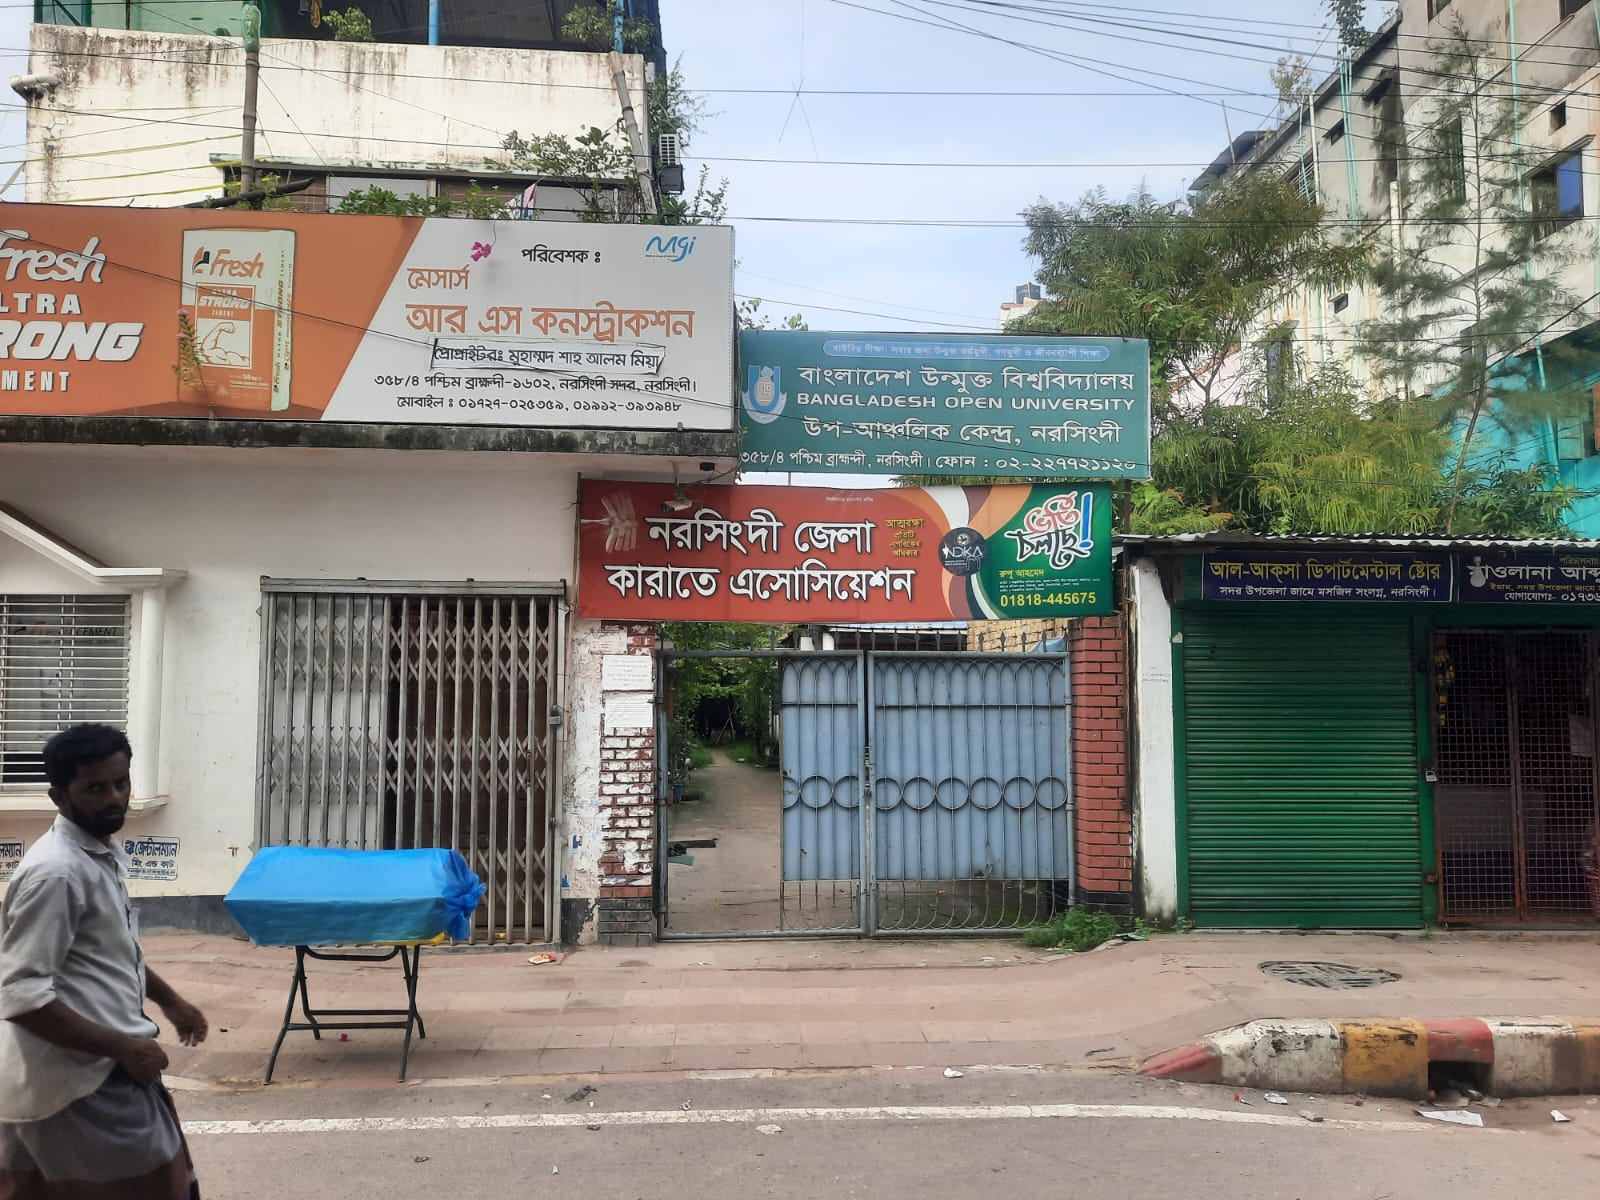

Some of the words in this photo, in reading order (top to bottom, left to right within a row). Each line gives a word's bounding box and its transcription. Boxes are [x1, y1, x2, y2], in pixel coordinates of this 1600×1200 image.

[209, 248, 264, 278] Fresh
[521, 243, 589, 263] পরিবেশক
[407, 264, 470, 290] মেসার্স
[405, 303, 468, 334] আর
[477, 306, 523, 335] এস
[531, 300, 695, 343] কনস্ট্রাকশন
[508, 349, 554, 366] মুহাম্মদ
[559, 351, 582, 365] শাহ
[586, 352, 626, 366] আলম
[374, 374, 420, 388] ৩৫৮/৪
[424, 372, 462, 388] পশ্চিম
[559, 375, 606, 392] নরসিংদী
[610, 380, 641, 393] সদর,
[796, 366, 912, 387] বাংলাদেশ
[919, 365, 993, 394] উন্মুক্ত
[1000, 366, 1135, 392] বিশ্ববিদ্যালয়
[396, 395, 444, 408] মোবাইল
[458, 398, 570, 412] ০১৭২৭-০২৫৩৫৯,
[573, 400, 682, 412] ০১৯১২-৩৯৩৯৪৮
[797, 393, 937, 408] BANGLADESH
[944, 396, 1003, 409] OPEN
[1011, 398, 1135, 411] UNIVERSITY
[802, 414, 951, 441] উপ-আঞ্চলিক
[960, 424, 1021, 446] কেন্দ্র,
[1030, 420, 1123, 445] নরসিংদী
[740, 449, 785, 464] ৩৫৮/৪
[789, 448, 822, 464] পশ্চিম
[876, 450, 923, 468] নরসিংদী
[936, 454, 976, 468] ফোন
[996, 457, 1136, 471] ০২-২২৭৭২১১২০
[644, 507, 785, 556] নরসিংদী
[794, 519, 878, 554] জেলা
[604, 562, 721, 599] কারাতে
[729, 557, 917, 602] এসোসিয়েশন
[1305, 557, 1403, 582] ডিপার্টমেন্টাল
[1000, 591, 1097, 607] 01818-445675
[1218, 586, 1242, 596] সদর
[1245, 583, 1287, 597] উপজেলা
[1289, 586, 1314, 597] জামে
[1318, 585, 1353, 598] মসজিদ
[1390, 584, 1430, 597] নরসিংদী
